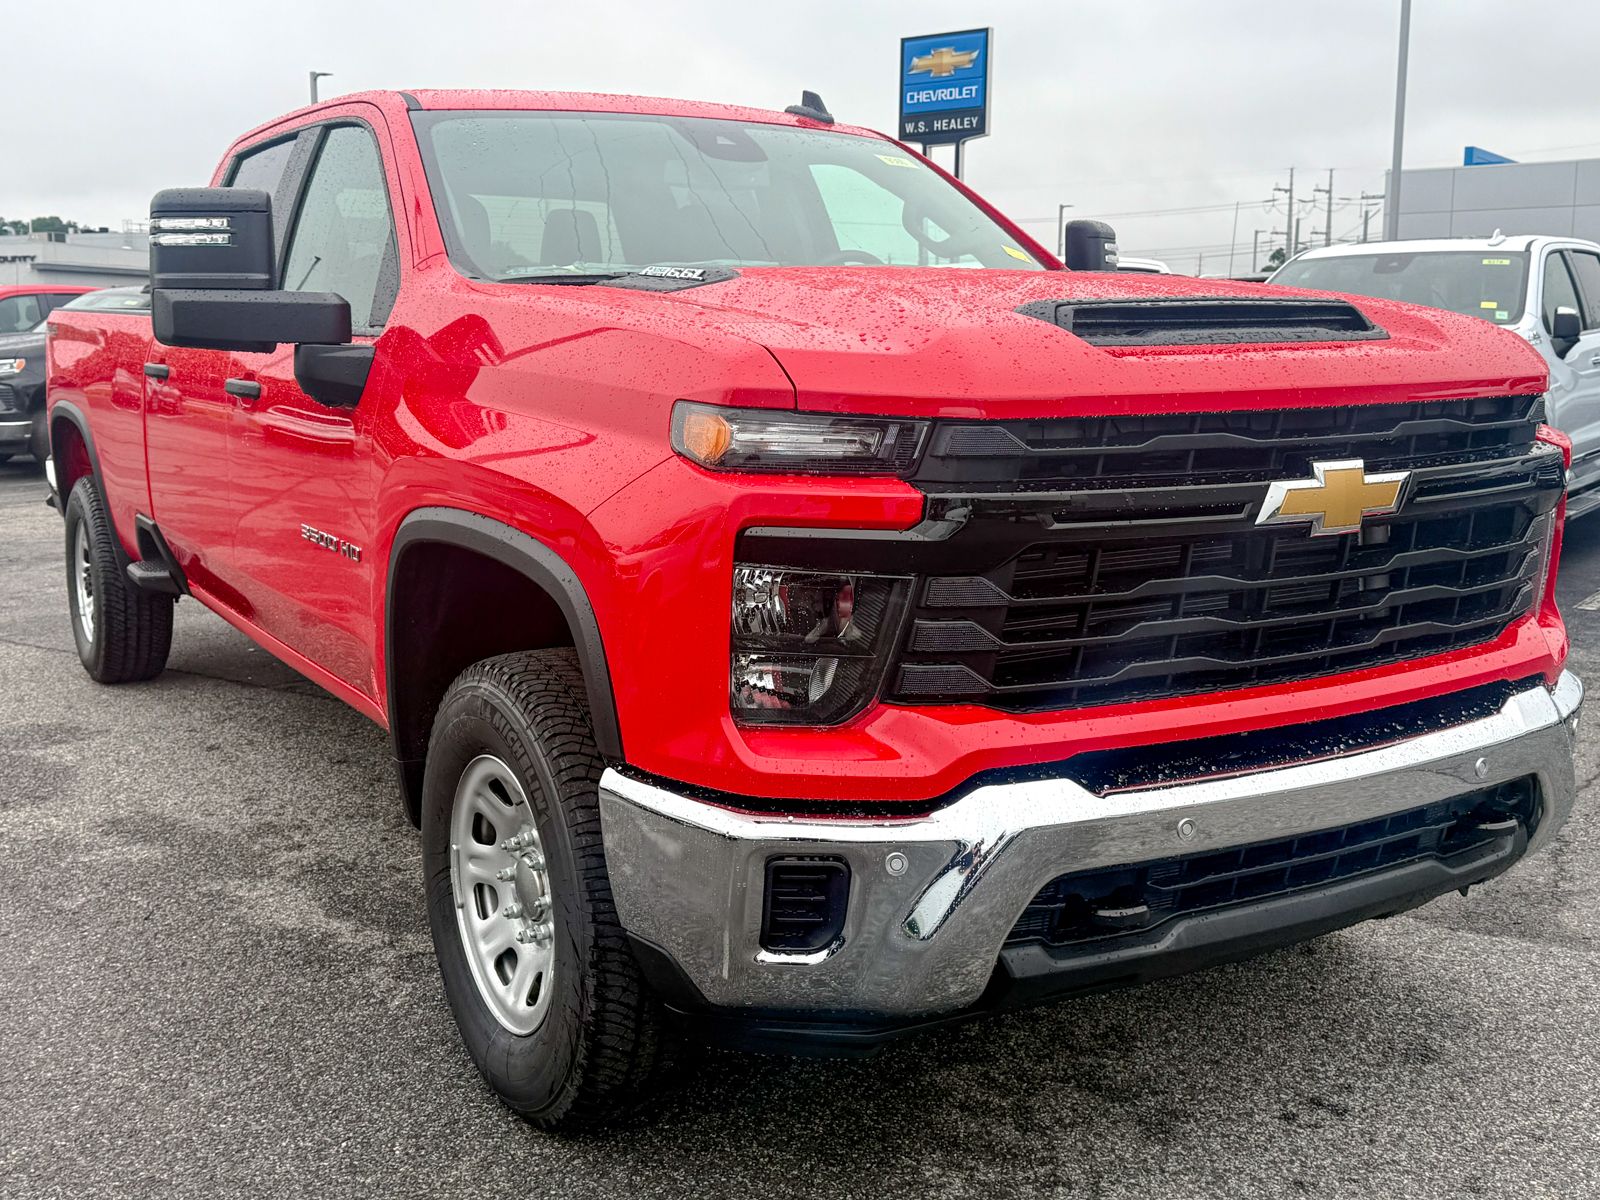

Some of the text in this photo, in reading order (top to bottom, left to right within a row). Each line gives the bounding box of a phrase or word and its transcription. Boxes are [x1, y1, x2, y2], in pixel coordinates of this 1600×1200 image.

[906, 85, 979, 104] CHEVROLET
[905, 116, 979, 133] W.S. HEALEY
[301, 523, 362, 562] 3500 HD
[492, 710, 548, 811] MICHELIN
